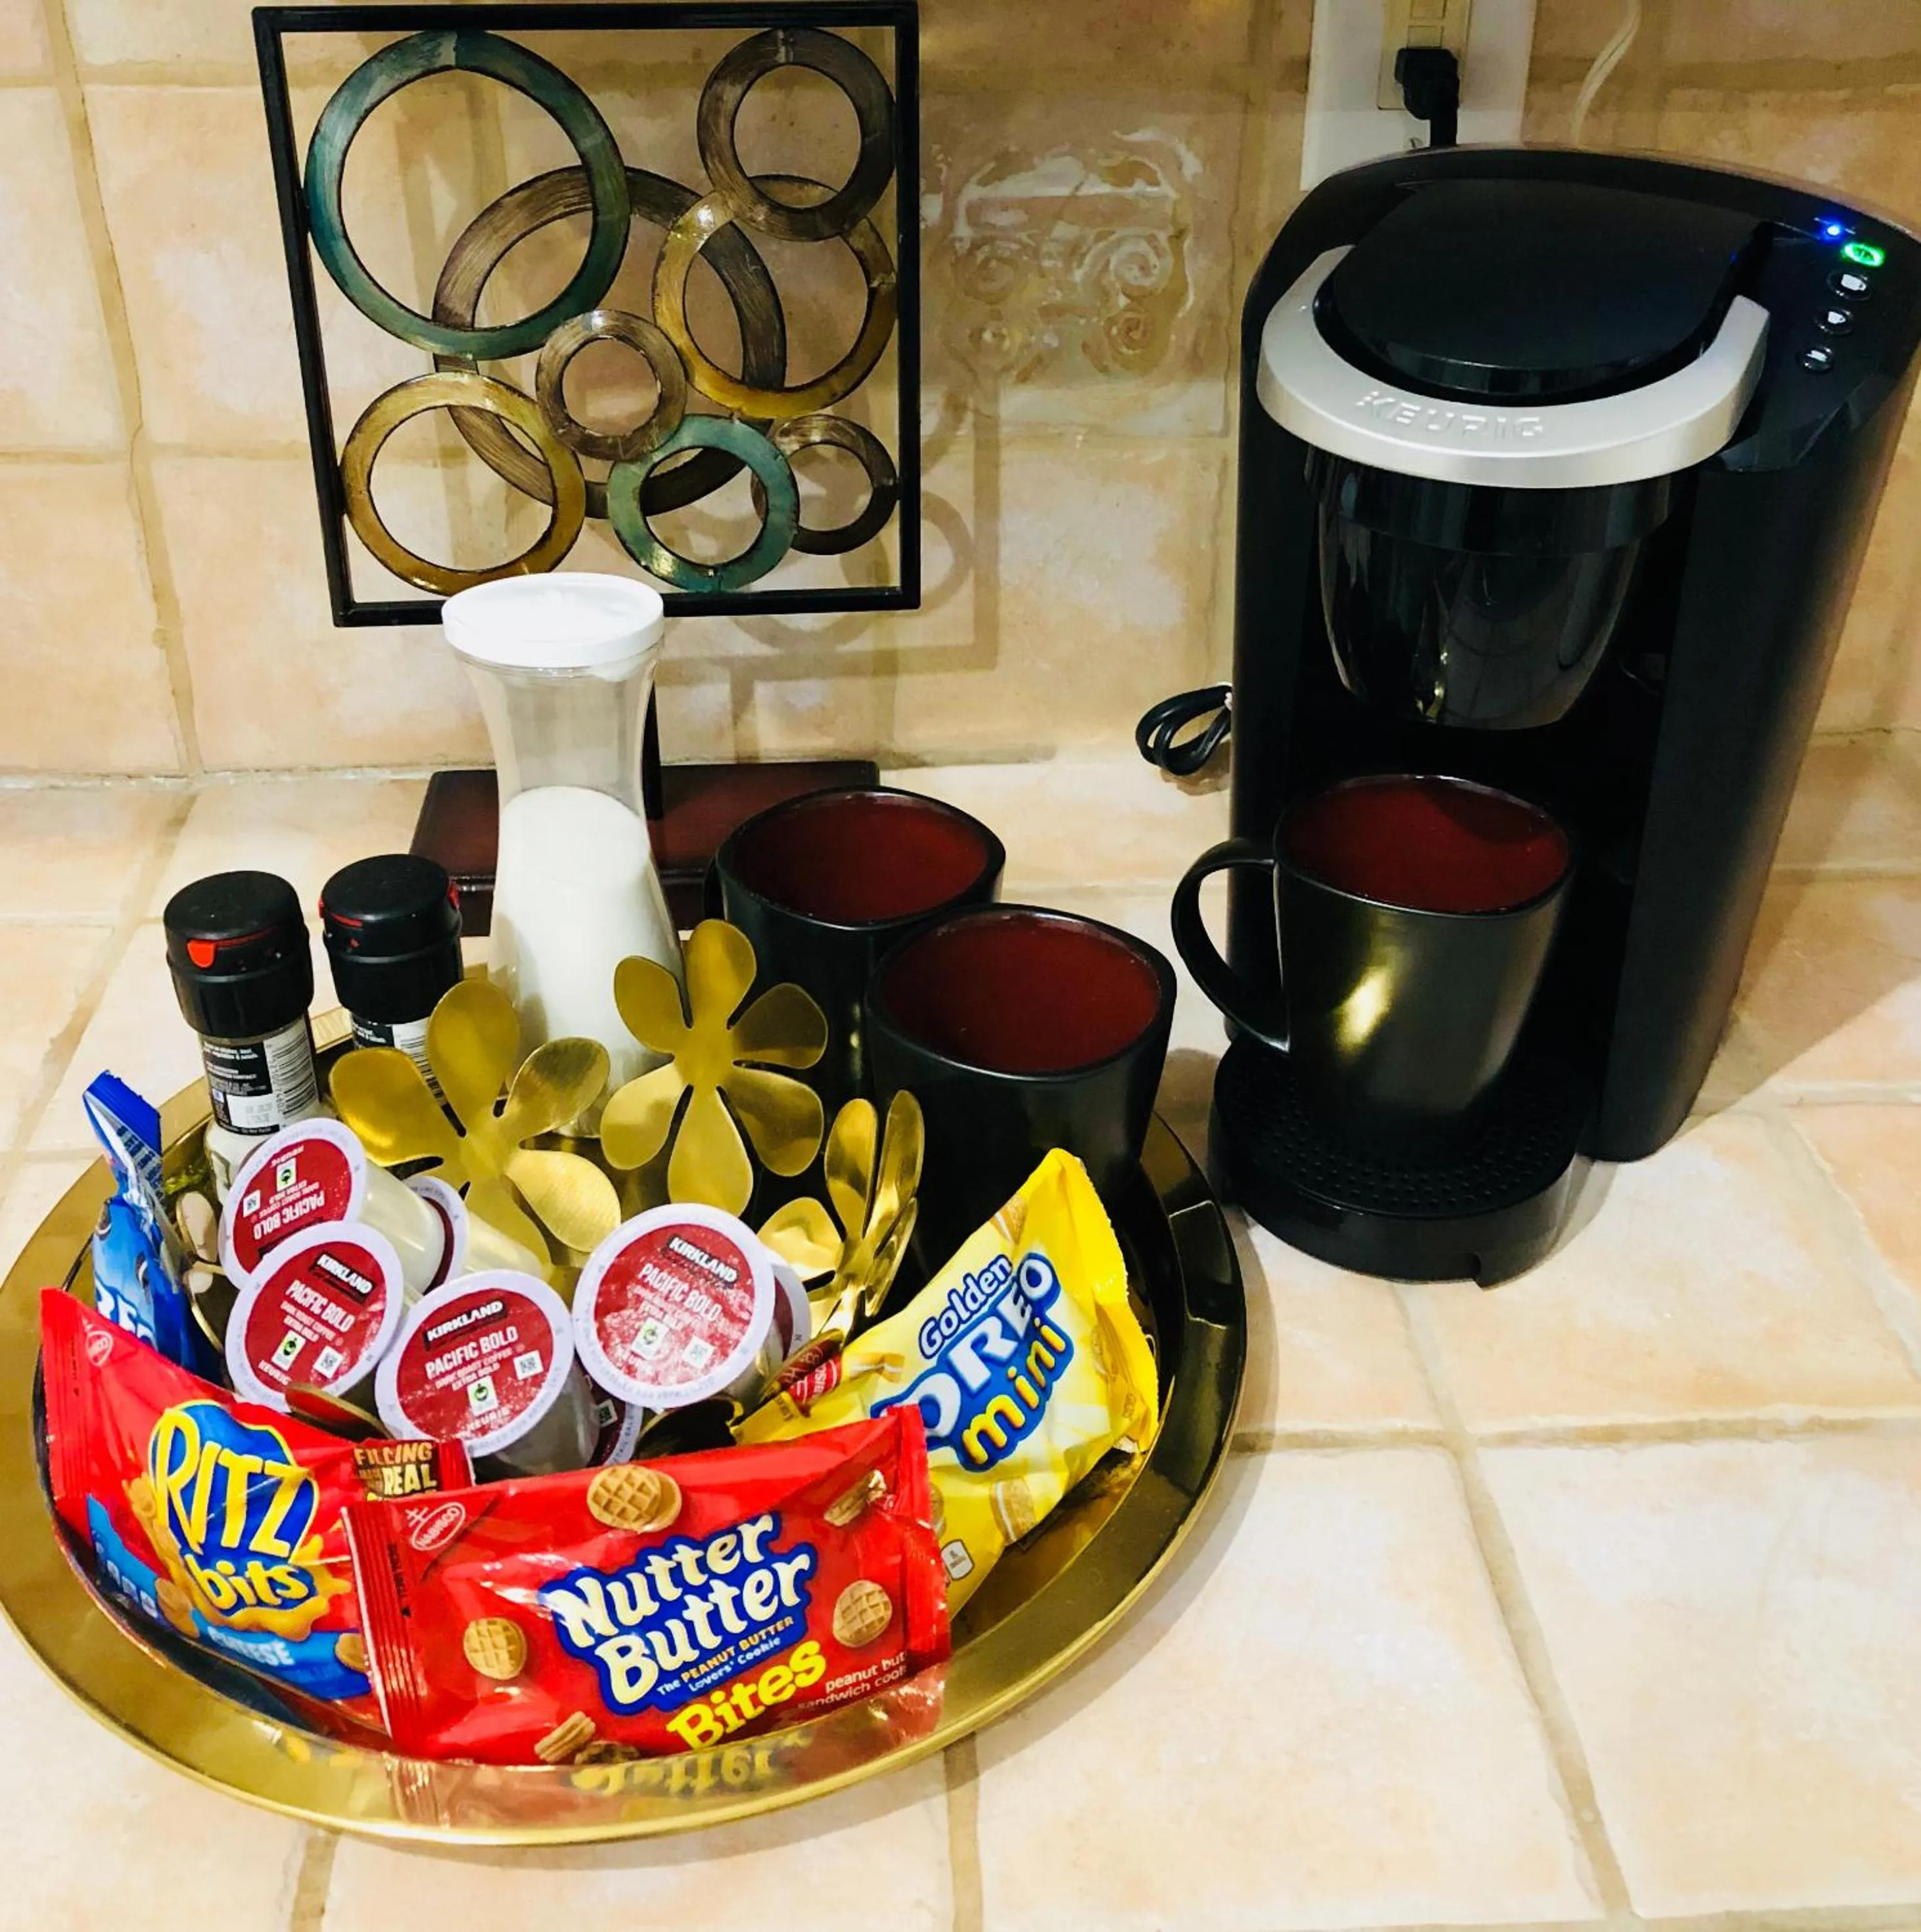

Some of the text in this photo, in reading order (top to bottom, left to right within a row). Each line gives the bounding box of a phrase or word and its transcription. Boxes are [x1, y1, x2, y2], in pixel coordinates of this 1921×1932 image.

[1354, 390, 1544, 439] KEURIG
[253, 1190, 325, 1240] PACIFIC BOLD
[317, 1254, 373, 1294] KIRKLAND
[669, 1237, 737, 1283] KIRKLAND
[285, 1279, 356, 1332] PACIFIC BOLD
[638, 1263, 689, 1303] PACIFIC
[685, 1289, 722, 1321] BOLD
[921, 1256, 1011, 1358] Golden
[427, 1300, 503, 1342] KIRKLAND
[425, 1326, 519, 1380] PACIFIC BOLD
[961, 1317, 1066, 1466] mini
[157, 1409, 309, 1558] RITZ
[382, 1463, 438, 1494] REAL
[185, 1554, 308, 1609] bits
[545, 1515, 774, 1647] Nutter
[595, 1554, 810, 1704] Butter
[657, 1616, 794, 1696] The PEANUT BUTTER
[737, 1637, 781, 1664] Cookie
[666, 1640, 826, 1750] Bites
[825, 1664, 878, 1693] peanut
